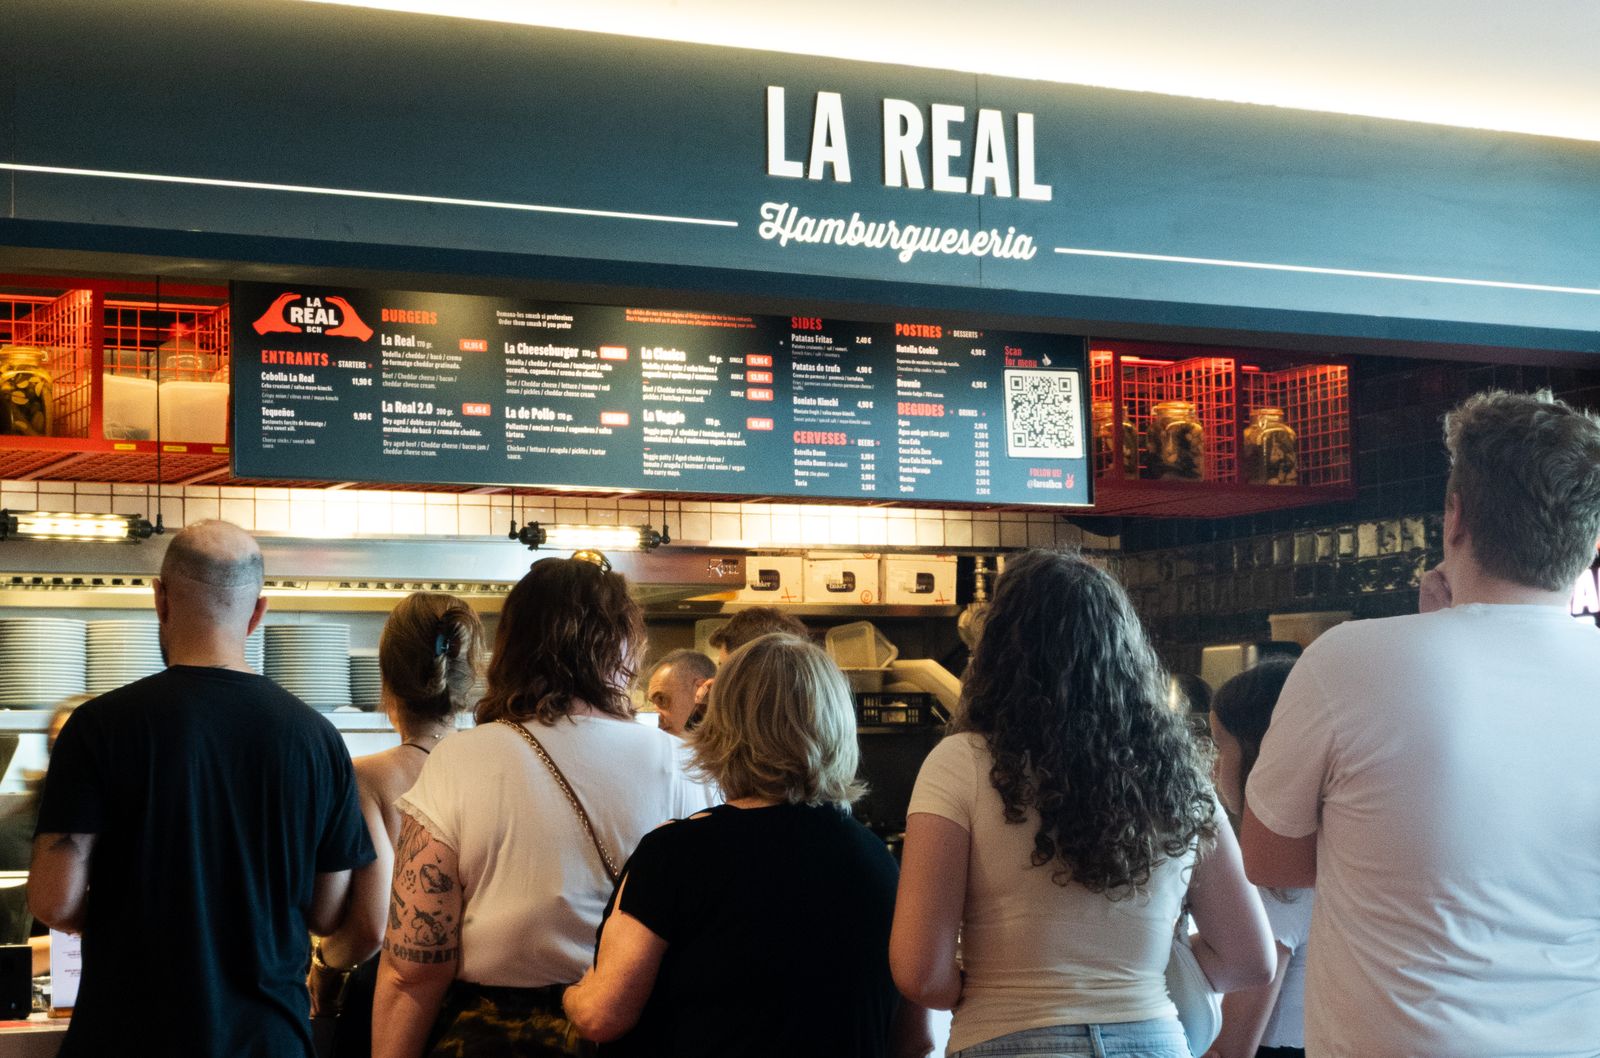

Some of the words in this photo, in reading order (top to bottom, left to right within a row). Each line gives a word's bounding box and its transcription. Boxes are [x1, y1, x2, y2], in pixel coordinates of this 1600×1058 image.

[767, 85, 851, 183] LA
[883, 98, 1052, 201] REAL
[759, 201, 1036, 263] Hamburgueseria
[306, 297, 321, 307] LA
[290, 307, 338, 325] REAL
[382, 308, 437, 325] BURGERS
[791, 317, 822, 330] SIDES
[896, 323, 942, 338] POSTRES
[381, 334, 392, 346] La
[394, 335, 415, 347] Real
[791, 334, 814, 342] Patatas
[815, 335, 832, 344] Fritas
[505, 342, 515, 354] La
[517, 343, 579, 359] Cheeseburger
[918, 346, 938, 355] Cookie
[1004, 346, 1023, 356] Scan
[261, 350, 328, 366] ENTRANTS
[338, 361, 366, 369] STARTERS
[1005, 357, 1016, 366] for
[1018, 359, 1037, 367] menu
[792, 362, 815, 371] Patatas
[816, 364, 824, 372] de
[825, 365, 840, 373] trufa
[261, 372, 288, 382] Cebolla
[289, 373, 297, 382] La
[299, 373, 314, 383] Real
[382, 400, 393, 413] La
[395, 401, 416, 414] Real
[418, 402, 433, 414] 2.0
[793, 396, 816, 405] Boniato
[817, 397, 839, 407] Kimchi
[262, 407, 295, 418] Tequeños
[505, 406, 516, 419] La
[518, 407, 529, 419] de
[531, 408, 555, 420] Pollo
[643, 409, 654, 422] La
[898, 402, 944, 417] BEGUDES
[793, 431, 847, 445] CERVESES
